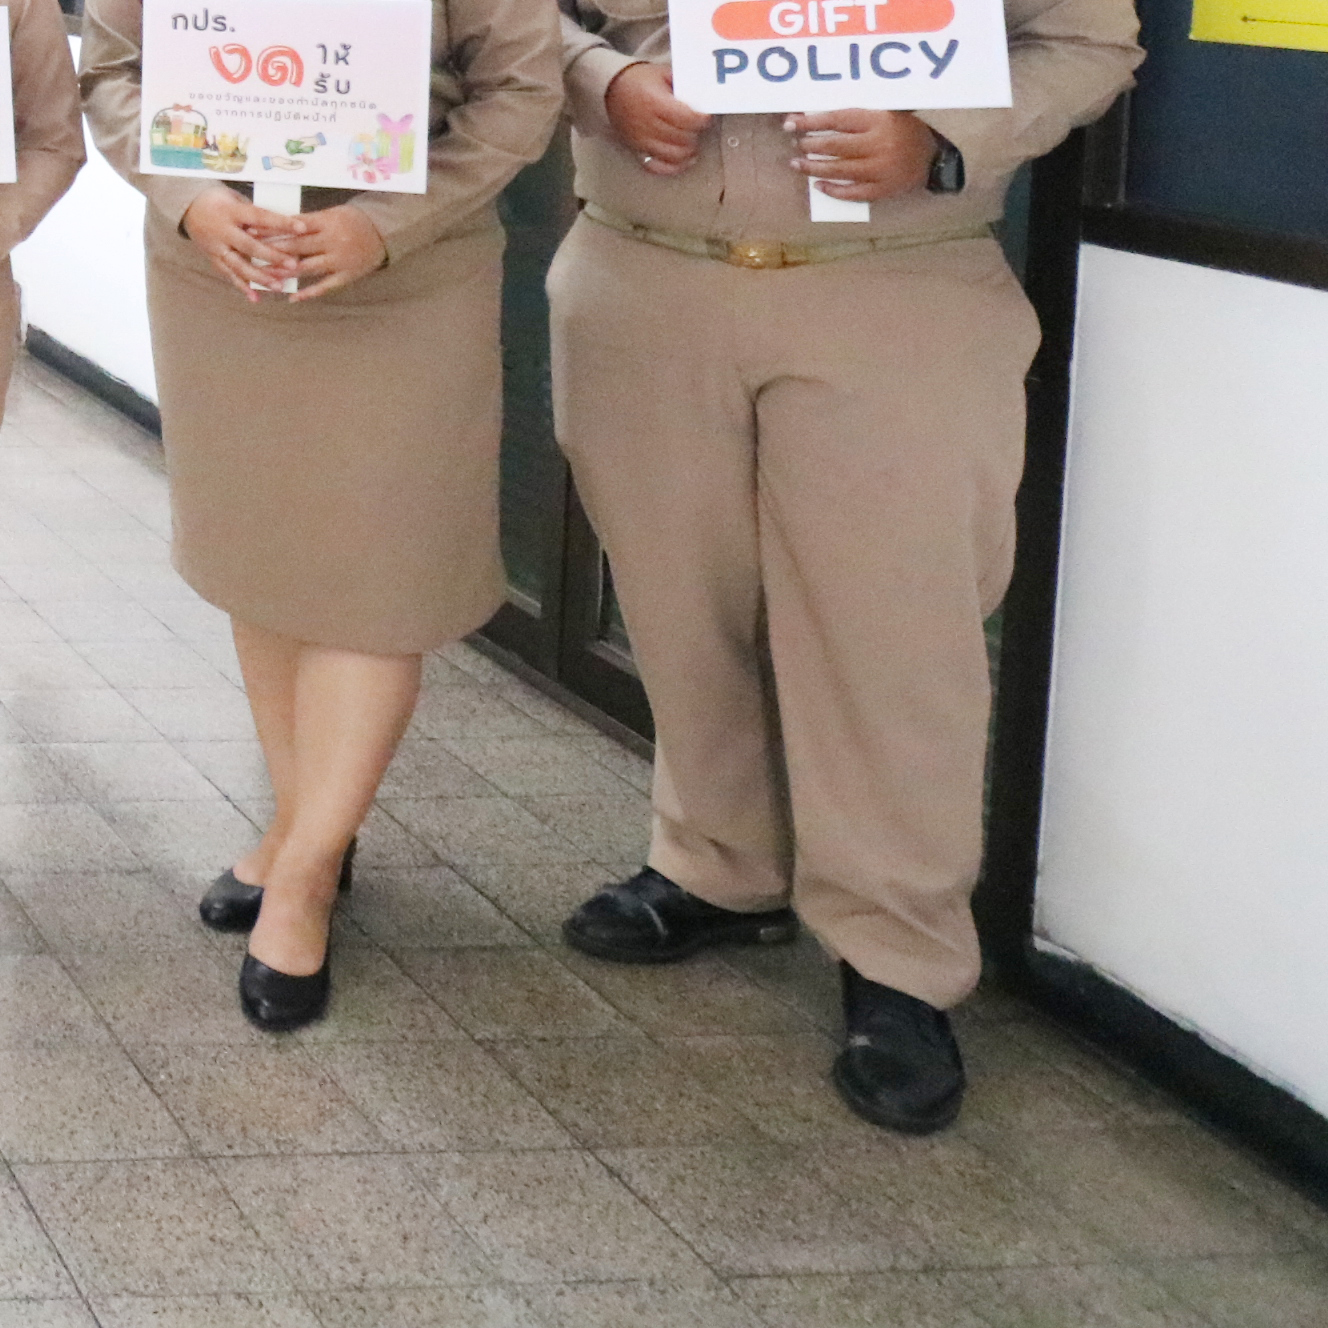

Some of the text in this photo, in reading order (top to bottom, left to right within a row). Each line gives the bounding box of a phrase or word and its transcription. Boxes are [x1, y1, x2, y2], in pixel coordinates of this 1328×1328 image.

[171, 8, 236, 33] กปร.
[208, 42, 352, 88] งด ให้
[711, 39, 960, 85] POLICY
[313, 72, 351, 95] รับ
